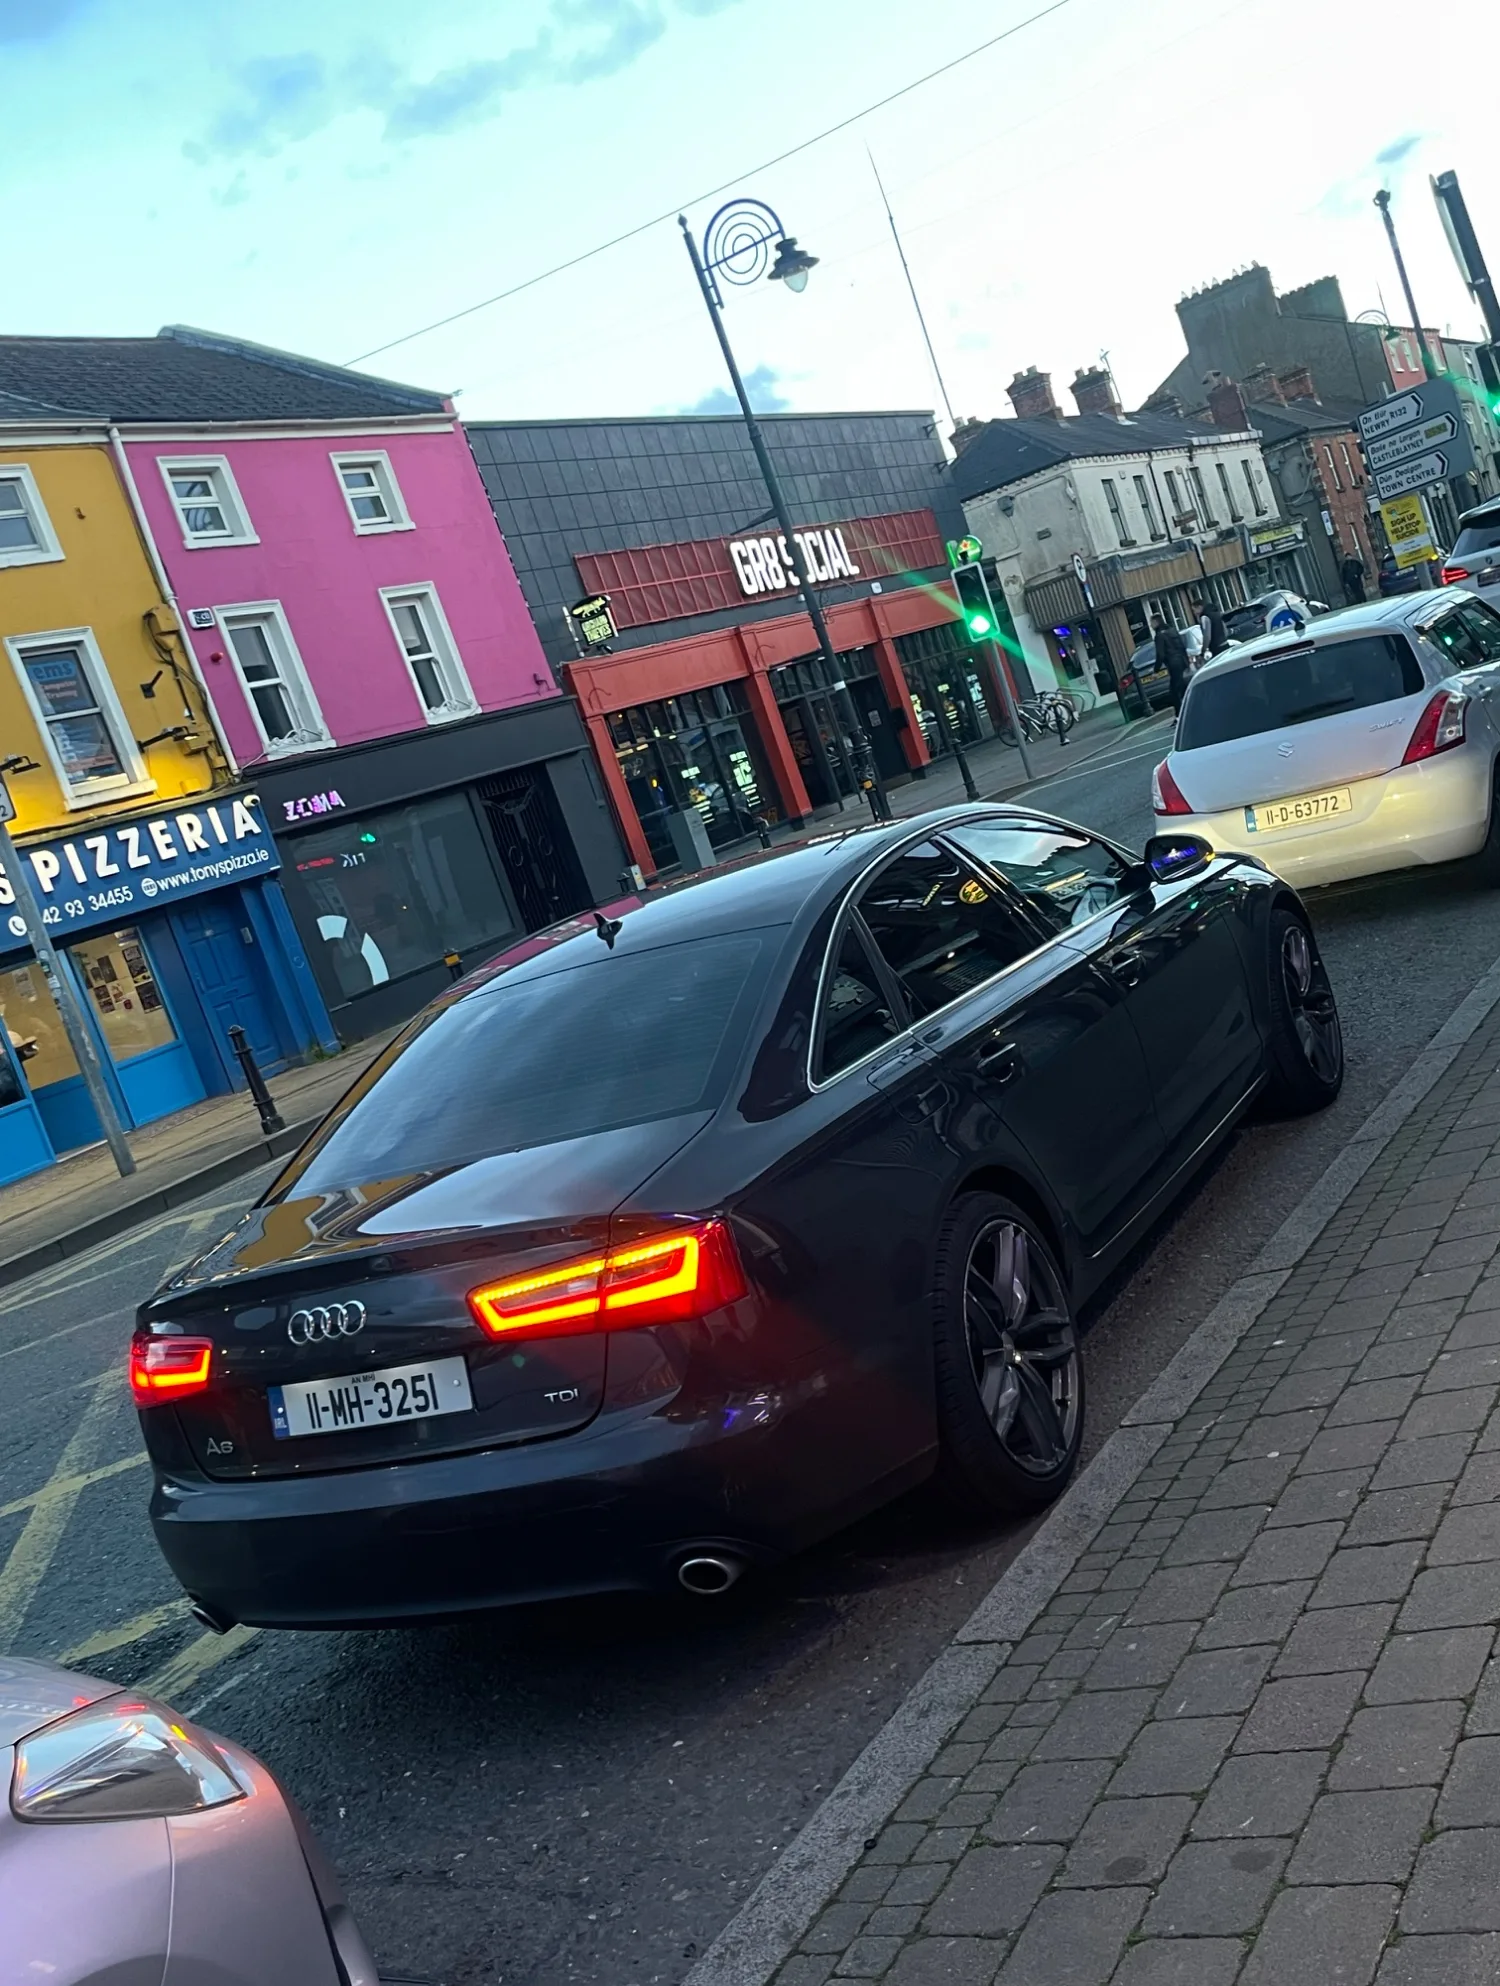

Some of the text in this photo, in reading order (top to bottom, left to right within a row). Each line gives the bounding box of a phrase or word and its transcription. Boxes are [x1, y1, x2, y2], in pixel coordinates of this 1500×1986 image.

[1390, 406, 1407, 419] R132
[1364, 418, 1390, 435] NEWRY
[1373, 439, 1424, 464] CASTLEBLAYNEY
[1381, 467, 1437, 494] TOWN CENTRE
[1266, 795, 1339, 825] 11-D-63772
[29, 800, 262, 893] PIZZERIA
[42, 848, 270, 924] 42 93 34455 www.tonyspizza.ie
[306, 1372, 440, 1430] 11-MH-3251
[206, 1436, 234, 1456] A6
